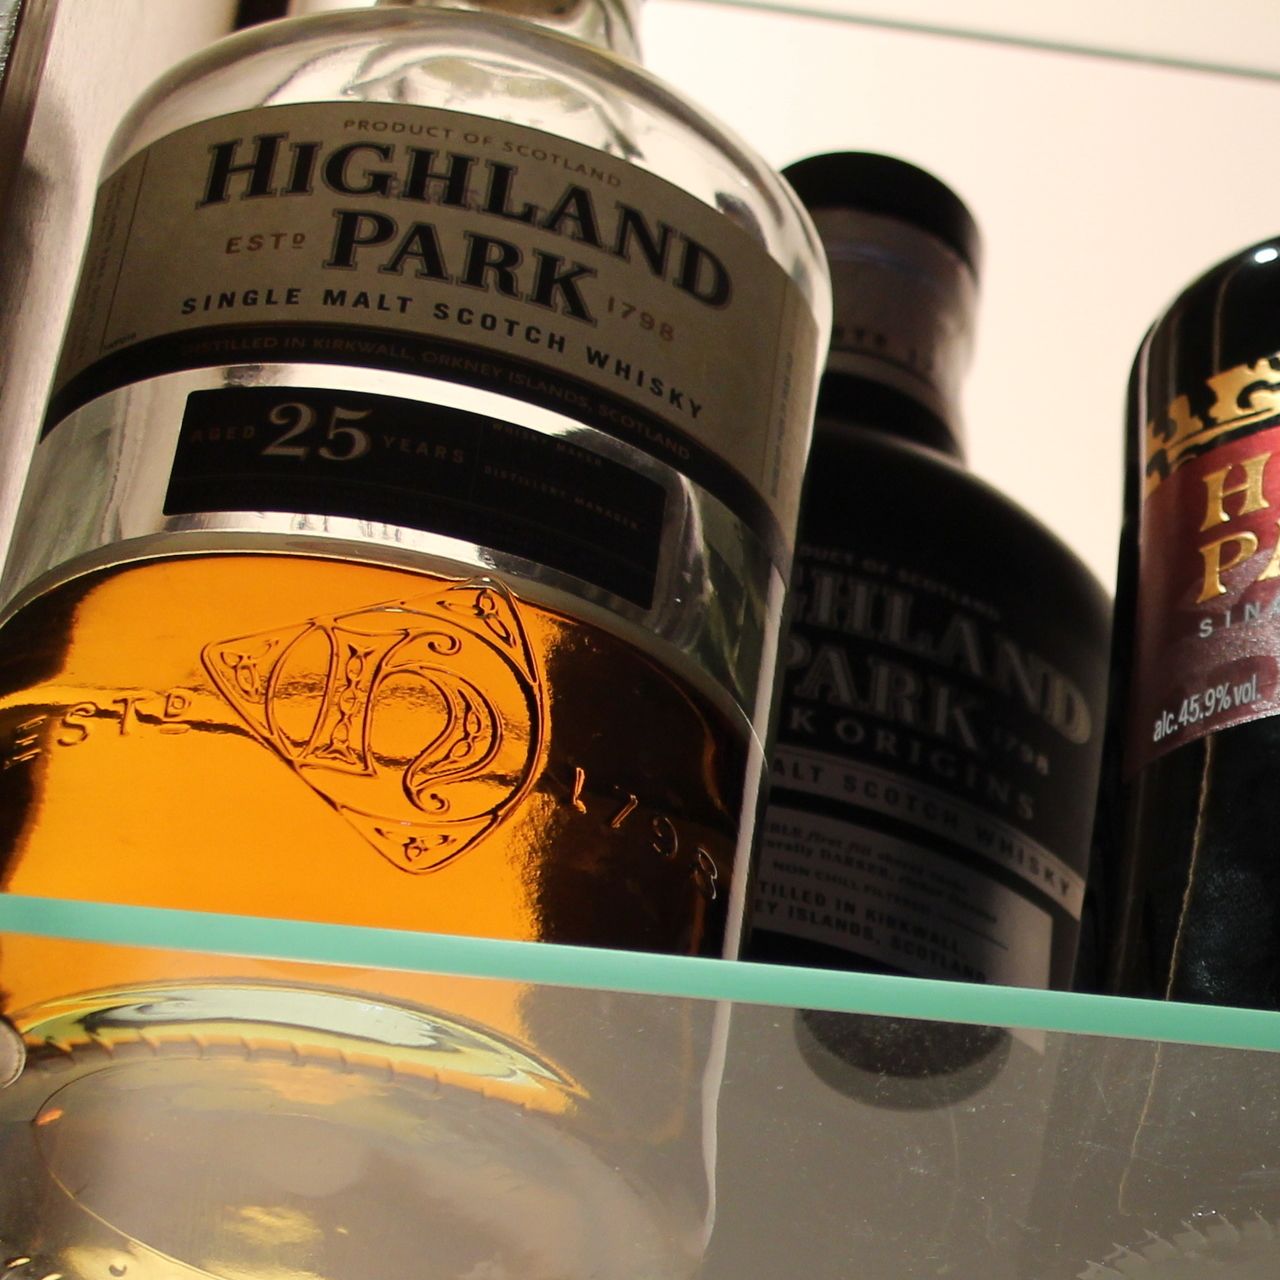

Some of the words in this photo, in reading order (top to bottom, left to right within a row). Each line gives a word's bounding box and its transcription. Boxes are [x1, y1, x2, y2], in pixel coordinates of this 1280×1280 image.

[344, 119, 452, 139] PRODUCT
[463, 132, 493, 147] OF
[504, 141, 622, 189] SCOTLAND
[195, 131, 734, 311] HIGHLAND
[321, 208, 598, 328] PARK
[181, 288, 301, 315] SINGLE
[322, 288, 413, 314] MALT
[433, 303, 566, 354] SCOTCH
[586, 345, 702, 420] WHISKY
[606, 296, 675, 342] 1798
[191, 425, 256, 443] AGED
[260, 401, 374, 462] 25
[382, 434, 465, 464] YEARS
[283, 336, 305, 349] IN
[421, 350, 503, 379] ORKNEY
[599, 404, 692, 462] SCOTLAND
[790, 566, 1093, 746] HLAND
[1232, 673, 1263, 708] vol.
[833, 716, 1035, 822] ORIGINS
[772, 757, 824, 783] ALT
[843, 775, 958, 830] SCOTCH
[975, 821, 1072, 899] WHISKY
[759, 880, 826, 906] TILLED
[835, 897, 856, 916] IN
